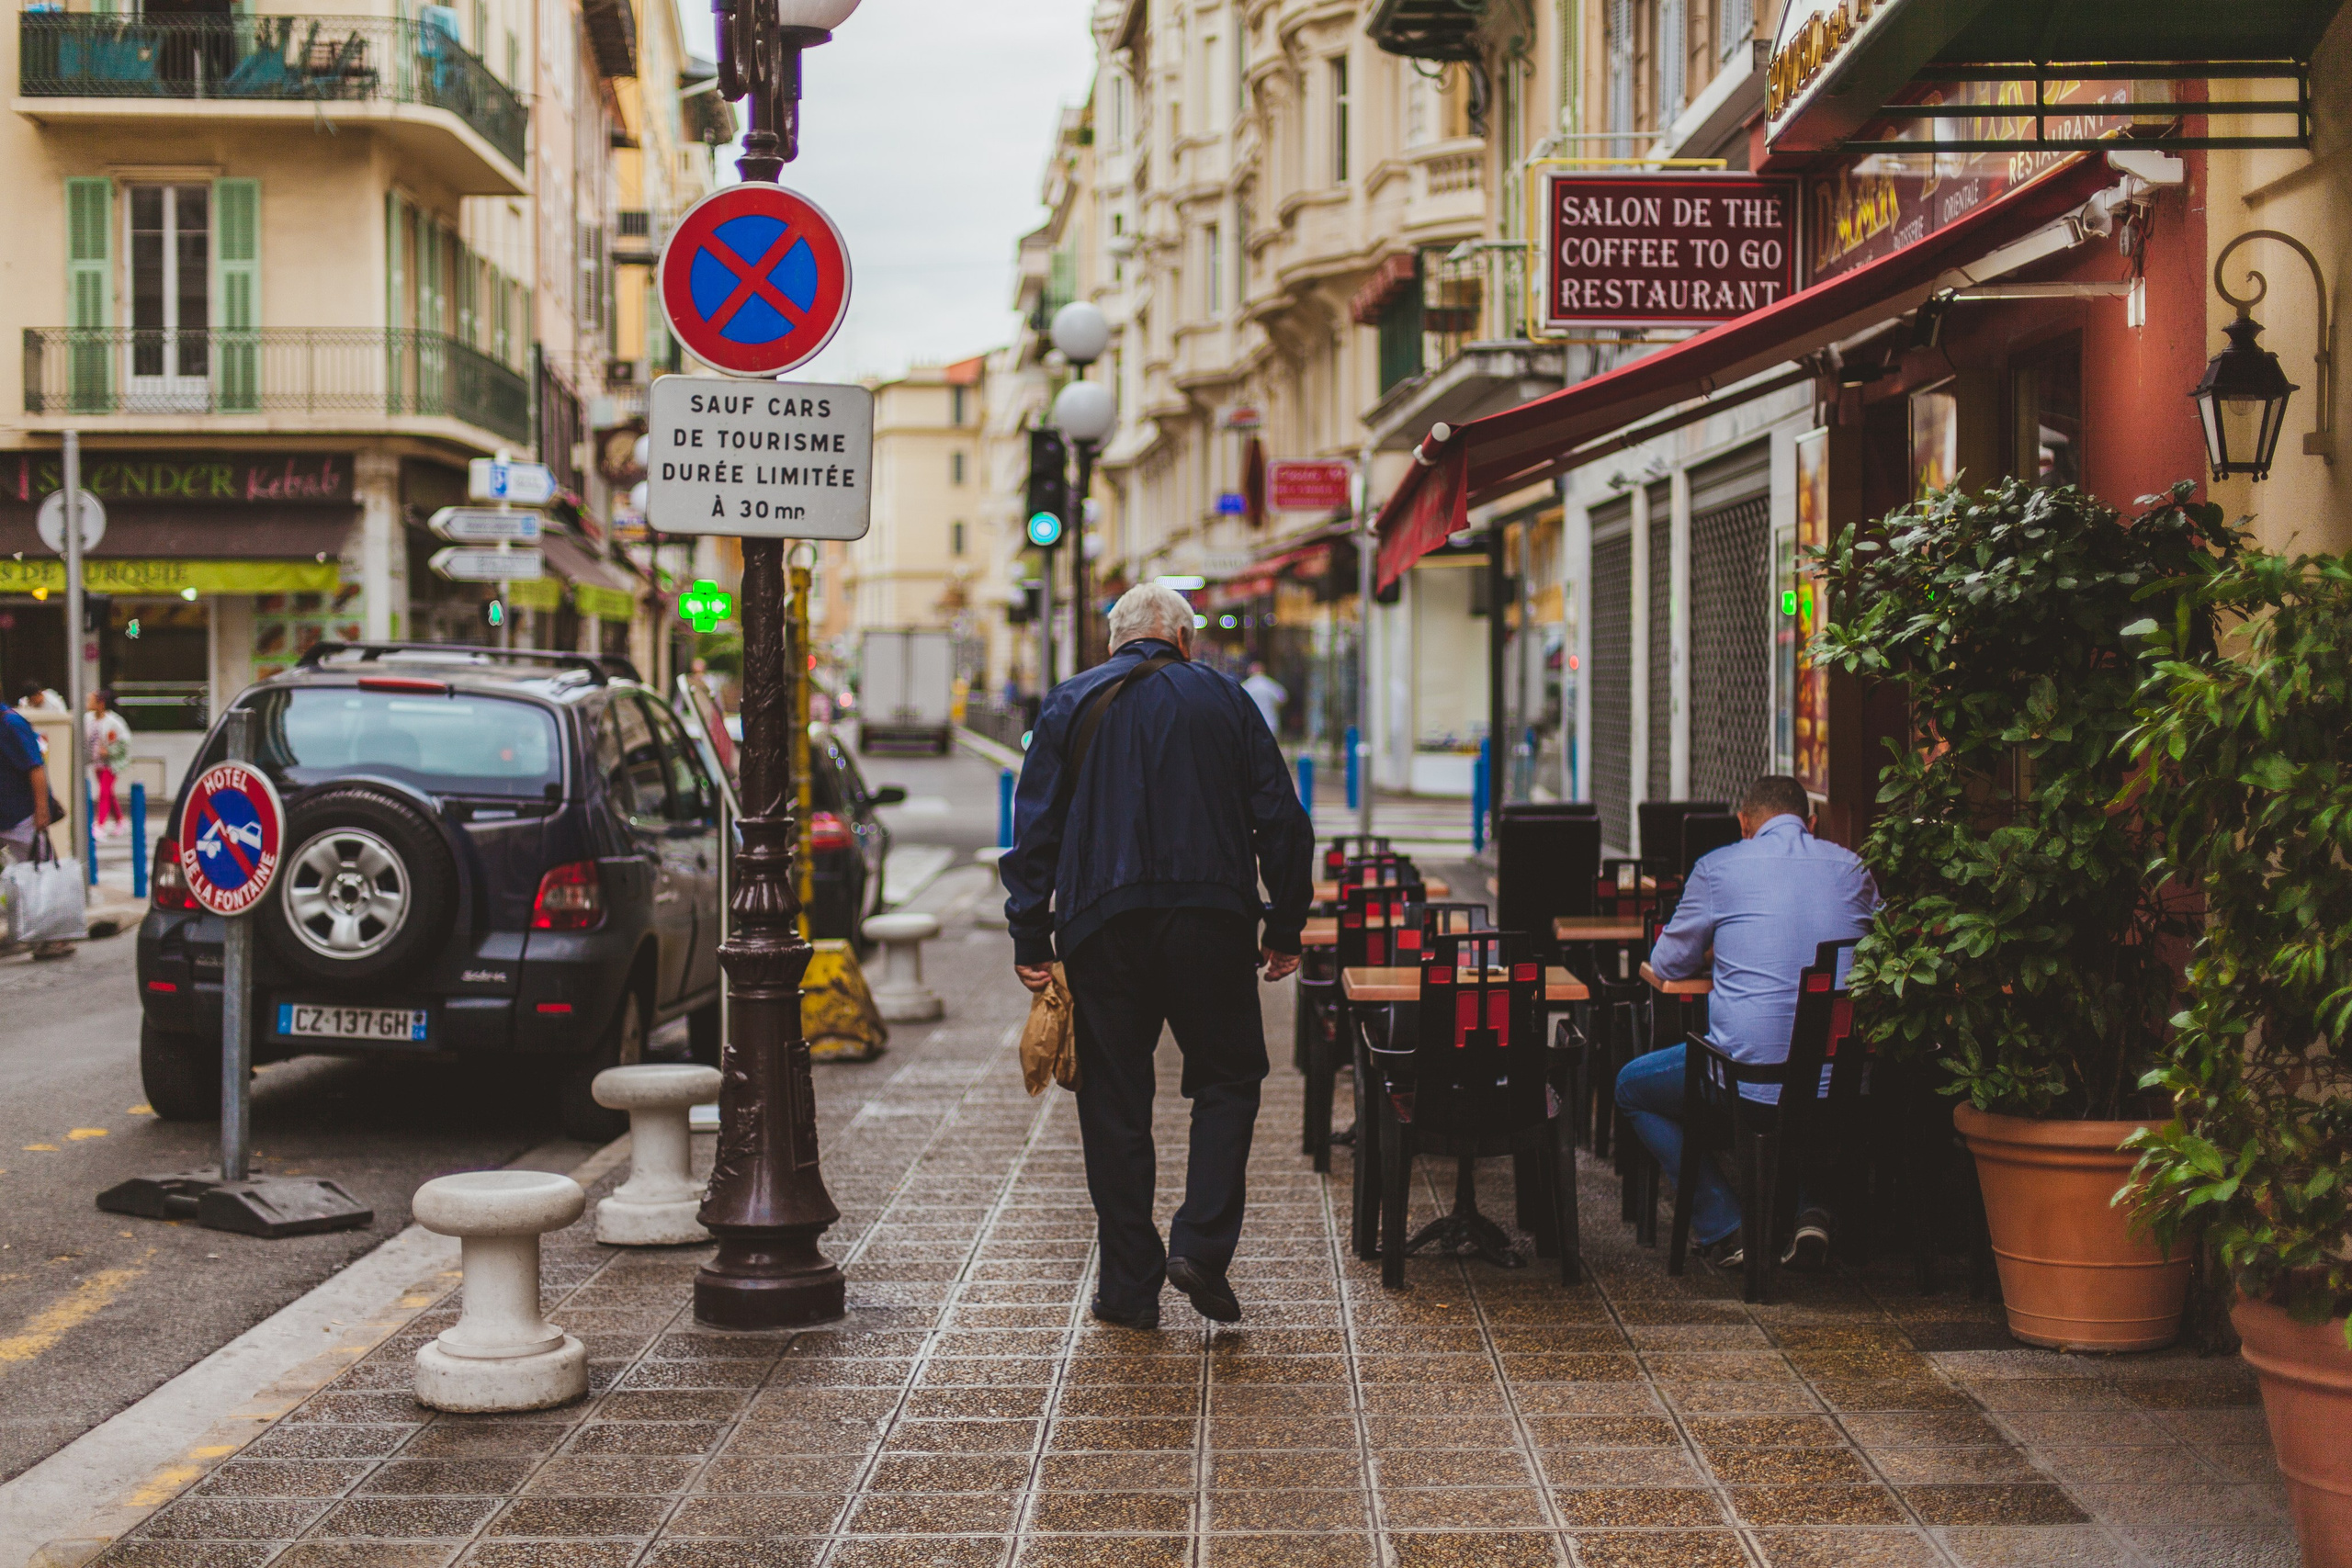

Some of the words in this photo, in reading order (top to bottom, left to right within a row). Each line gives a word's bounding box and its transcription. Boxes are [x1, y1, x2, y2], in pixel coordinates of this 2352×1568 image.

[1561, 196, 1662, 228] SALON
[1672, 197, 1712, 228] DE
[1721, 194, 1783, 229] THÉ
[1561, 237, 1679, 268] COFFEE
[1689, 238, 1730, 269] TO
[1739, 239, 1782, 270] GO
[1561, 278, 1781, 311] RESTAURANT
[690, 394, 755, 415] SAUF
[767, 398, 831, 418] CARS
[673, 428, 704, 448] DE
[717, 430, 845, 454] TOURISME
[17, 458, 238, 502] ISENDER
[246, 457, 341, 502] Kebab
[662, 460, 744, 484] DURÉE
[756, 464, 855, 488] LIMITÉE
[711, 494, 726, 518] À
[740, 500, 769, 519] 30
[80, 561, 189, 583] URQUIE
[202, 767, 248, 796] HOTEL
[183, 847, 201, 880] DE
[194, 874, 212, 907] LA
[213, 850, 277, 910] FONTAINE
